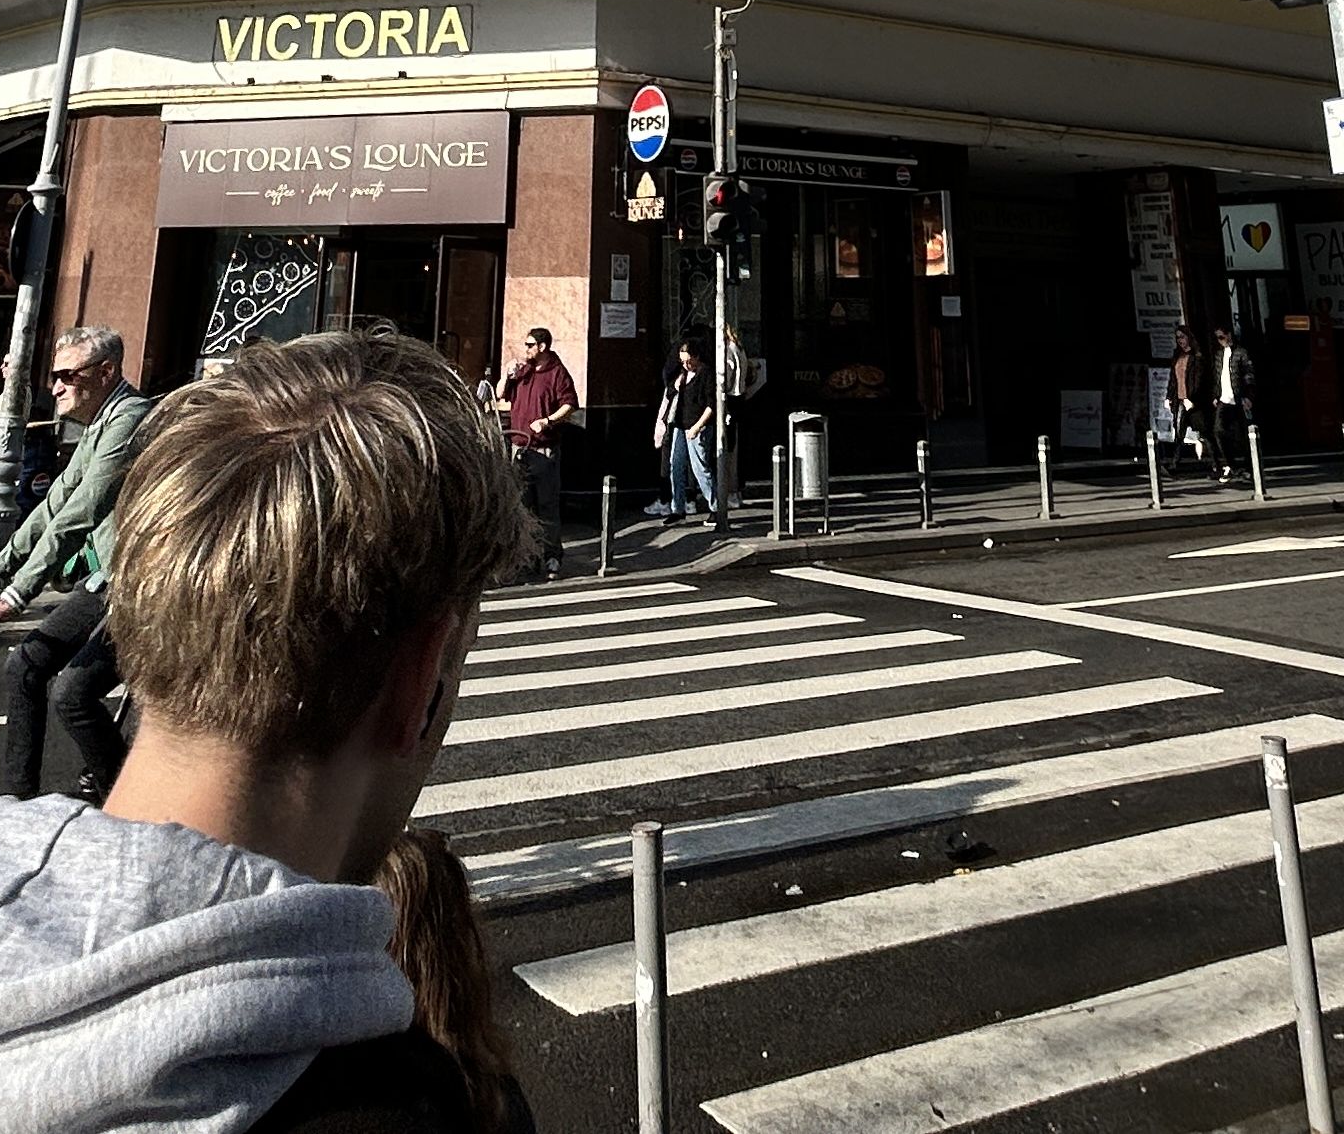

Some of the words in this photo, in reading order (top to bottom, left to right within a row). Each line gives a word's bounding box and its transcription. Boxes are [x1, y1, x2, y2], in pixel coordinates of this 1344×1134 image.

[218, 6, 471, 61] VICTORIA
[631, 115, 665, 132] PEPSI
[179, 146, 353, 173] VICTORIA'S
[363, 141, 489, 171] LOUNGE
[264, 184, 296, 206] coffee
[308, 182, 339, 204] food
